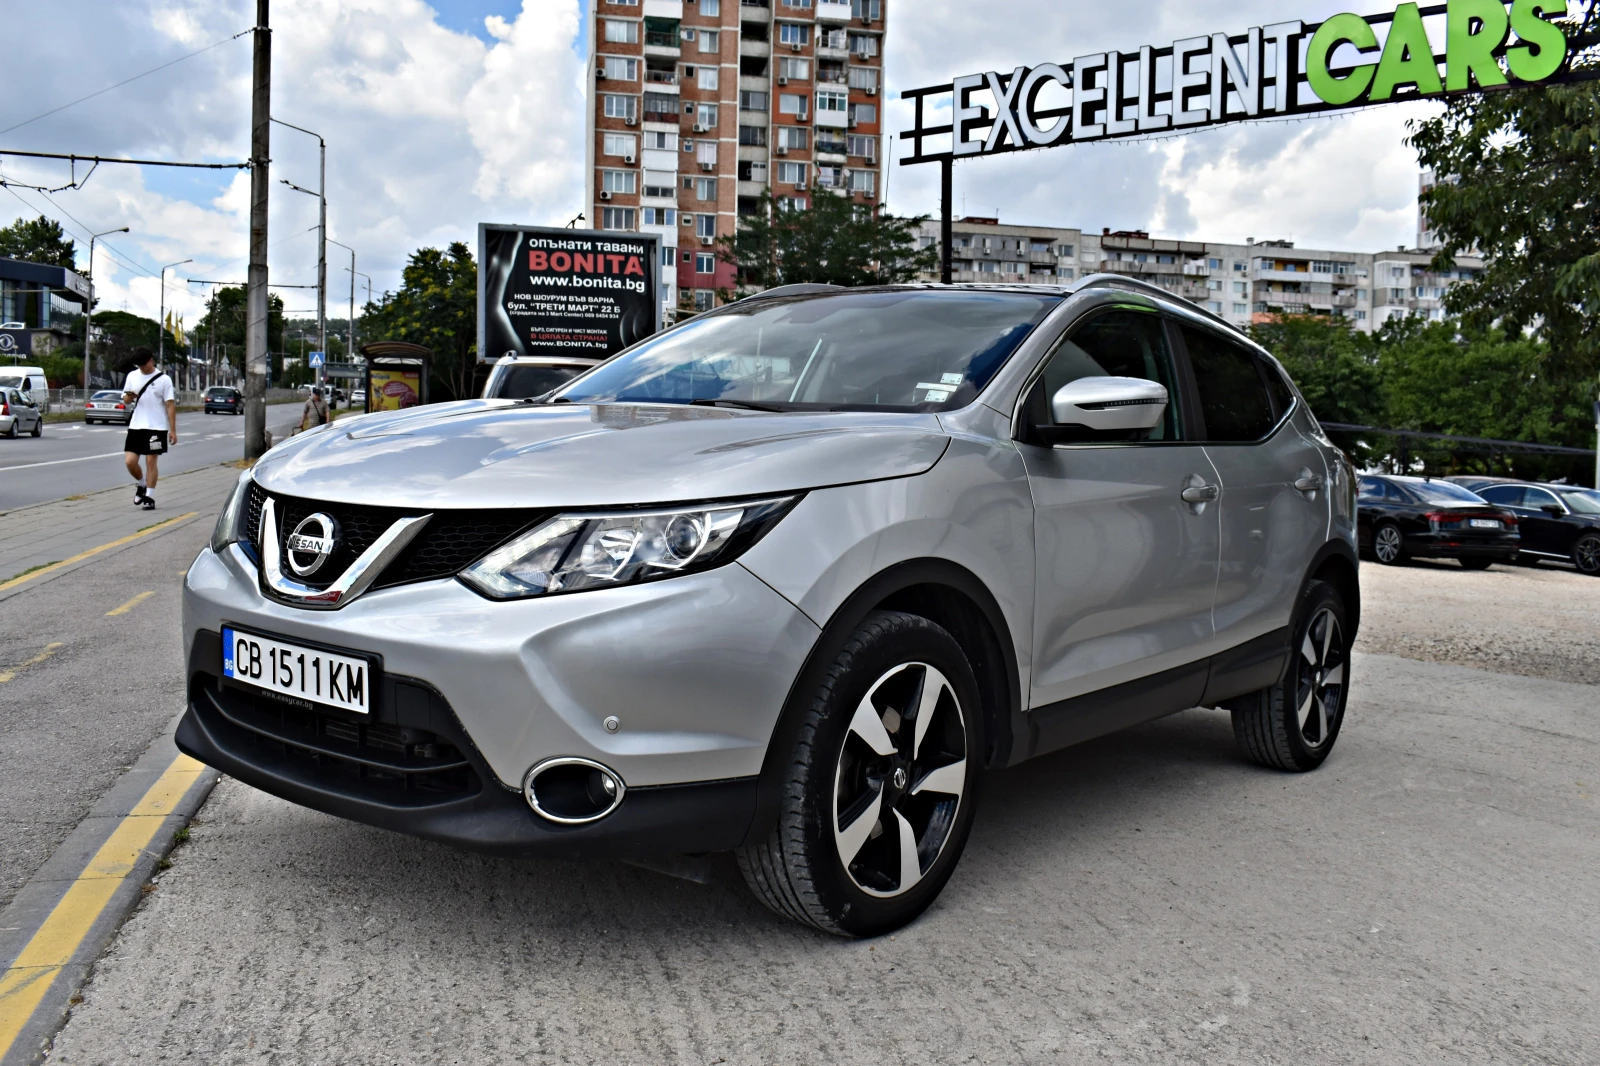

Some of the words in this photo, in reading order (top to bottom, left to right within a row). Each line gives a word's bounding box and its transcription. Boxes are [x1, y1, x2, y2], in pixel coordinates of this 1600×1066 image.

[953, 20, 1302, 155] EXCELLENT
[1306, 0, 1567, 105] CARS
[528, 238, 592, 251] опънати
[596, 242, 644, 254] тавани
[529, 250, 644, 276] BONITA
[529, 275, 645, 293] www.bonita.bg
[508, 302, 528, 311] бул.
[588, 296, 615, 304] ВАРНА
[531, 340, 608, 349] www.BONITA.bg
[290, 535, 324, 550] NISSAN
[225, 658, 233, 671] BG
[236, 639, 262, 679] CB
[269, 647, 321, 696] 1511
[329, 660, 364, 707] KM
[261, 690, 314, 710] www.easycar.bg
